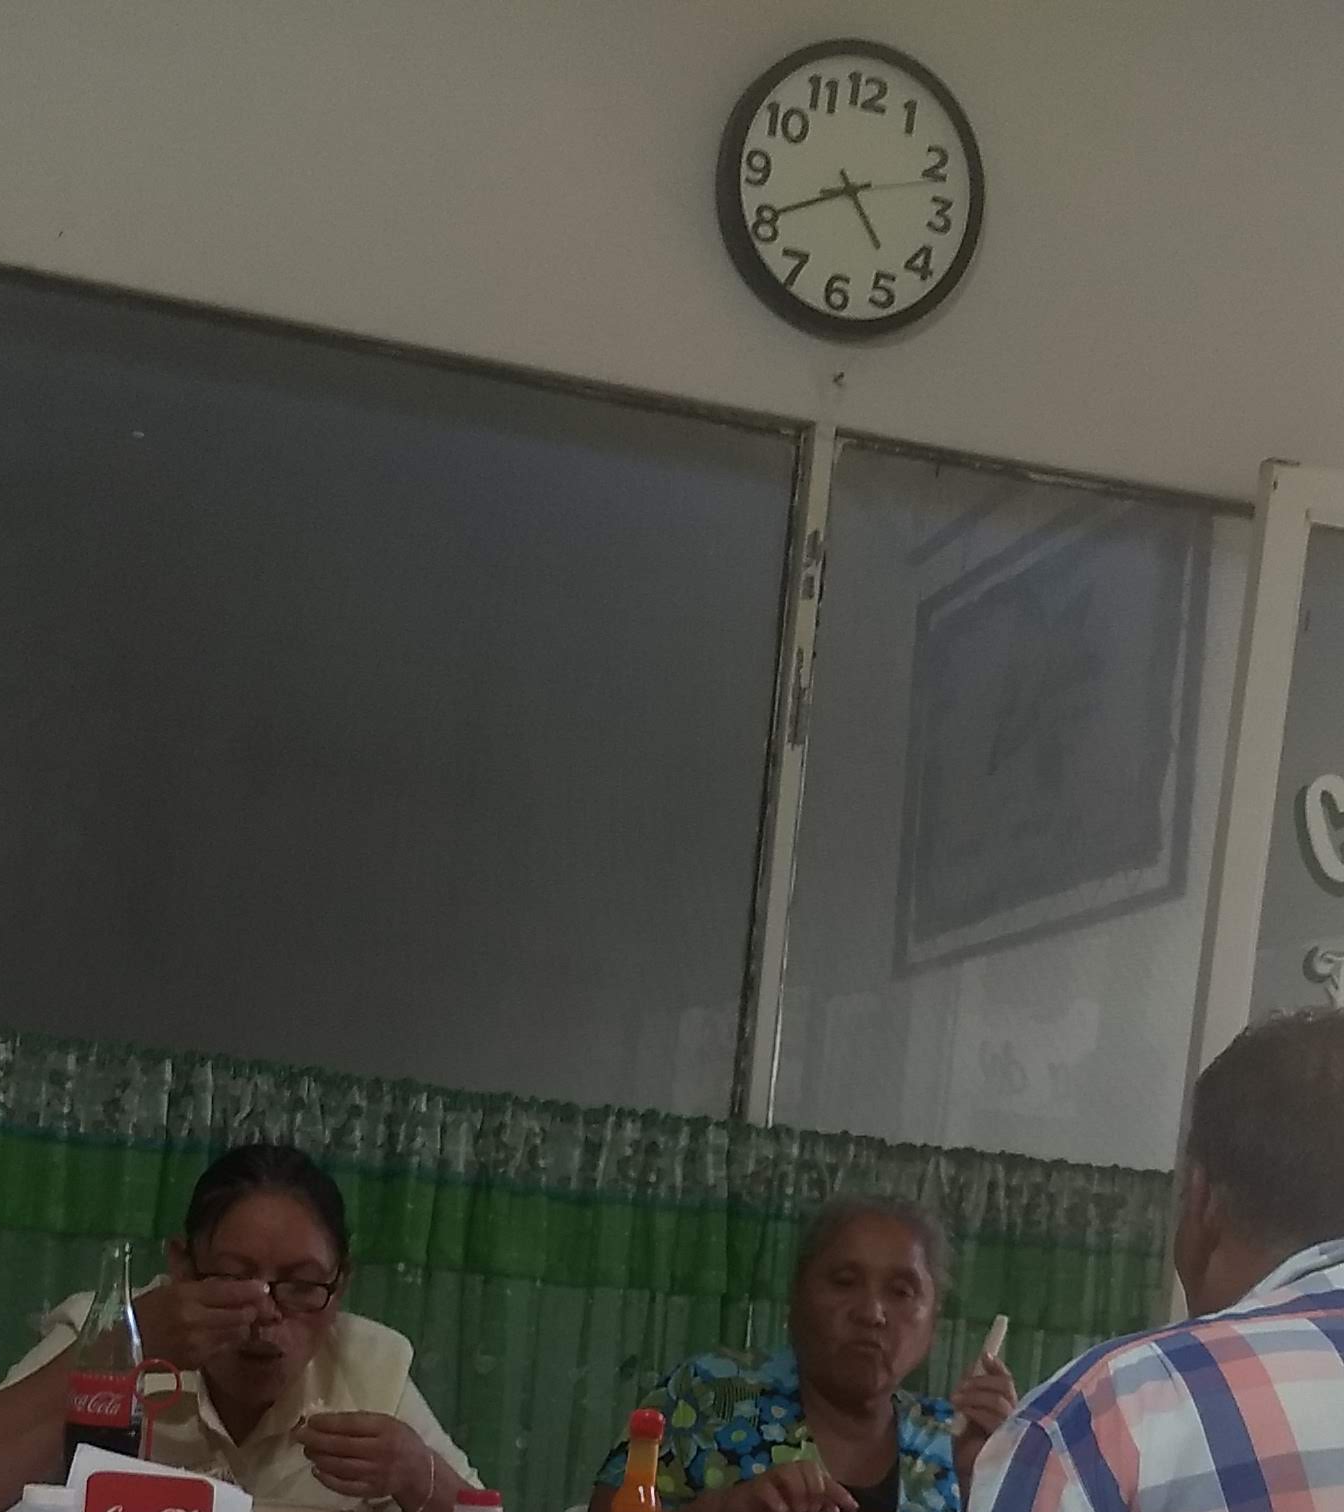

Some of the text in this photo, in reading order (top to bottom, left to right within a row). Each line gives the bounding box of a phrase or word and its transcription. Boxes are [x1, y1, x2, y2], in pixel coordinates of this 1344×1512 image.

[808, 73, 839, 114] 11
[848, 71, 889, 115] 12
[766, 101, 810, 144] 10
[903, 99, 918, 135] 1
[745, 149, 772, 187] 9
[920, 145, 950, 183] 2
[751, 203, 780, 243] 8
[926, 196, 953, 235] 3
[782, 247, 810, 289] 7
[903, 245, 934, 281] 4
[824, 273, 851, 312] 6
[868, 270, 897, 309] 5
